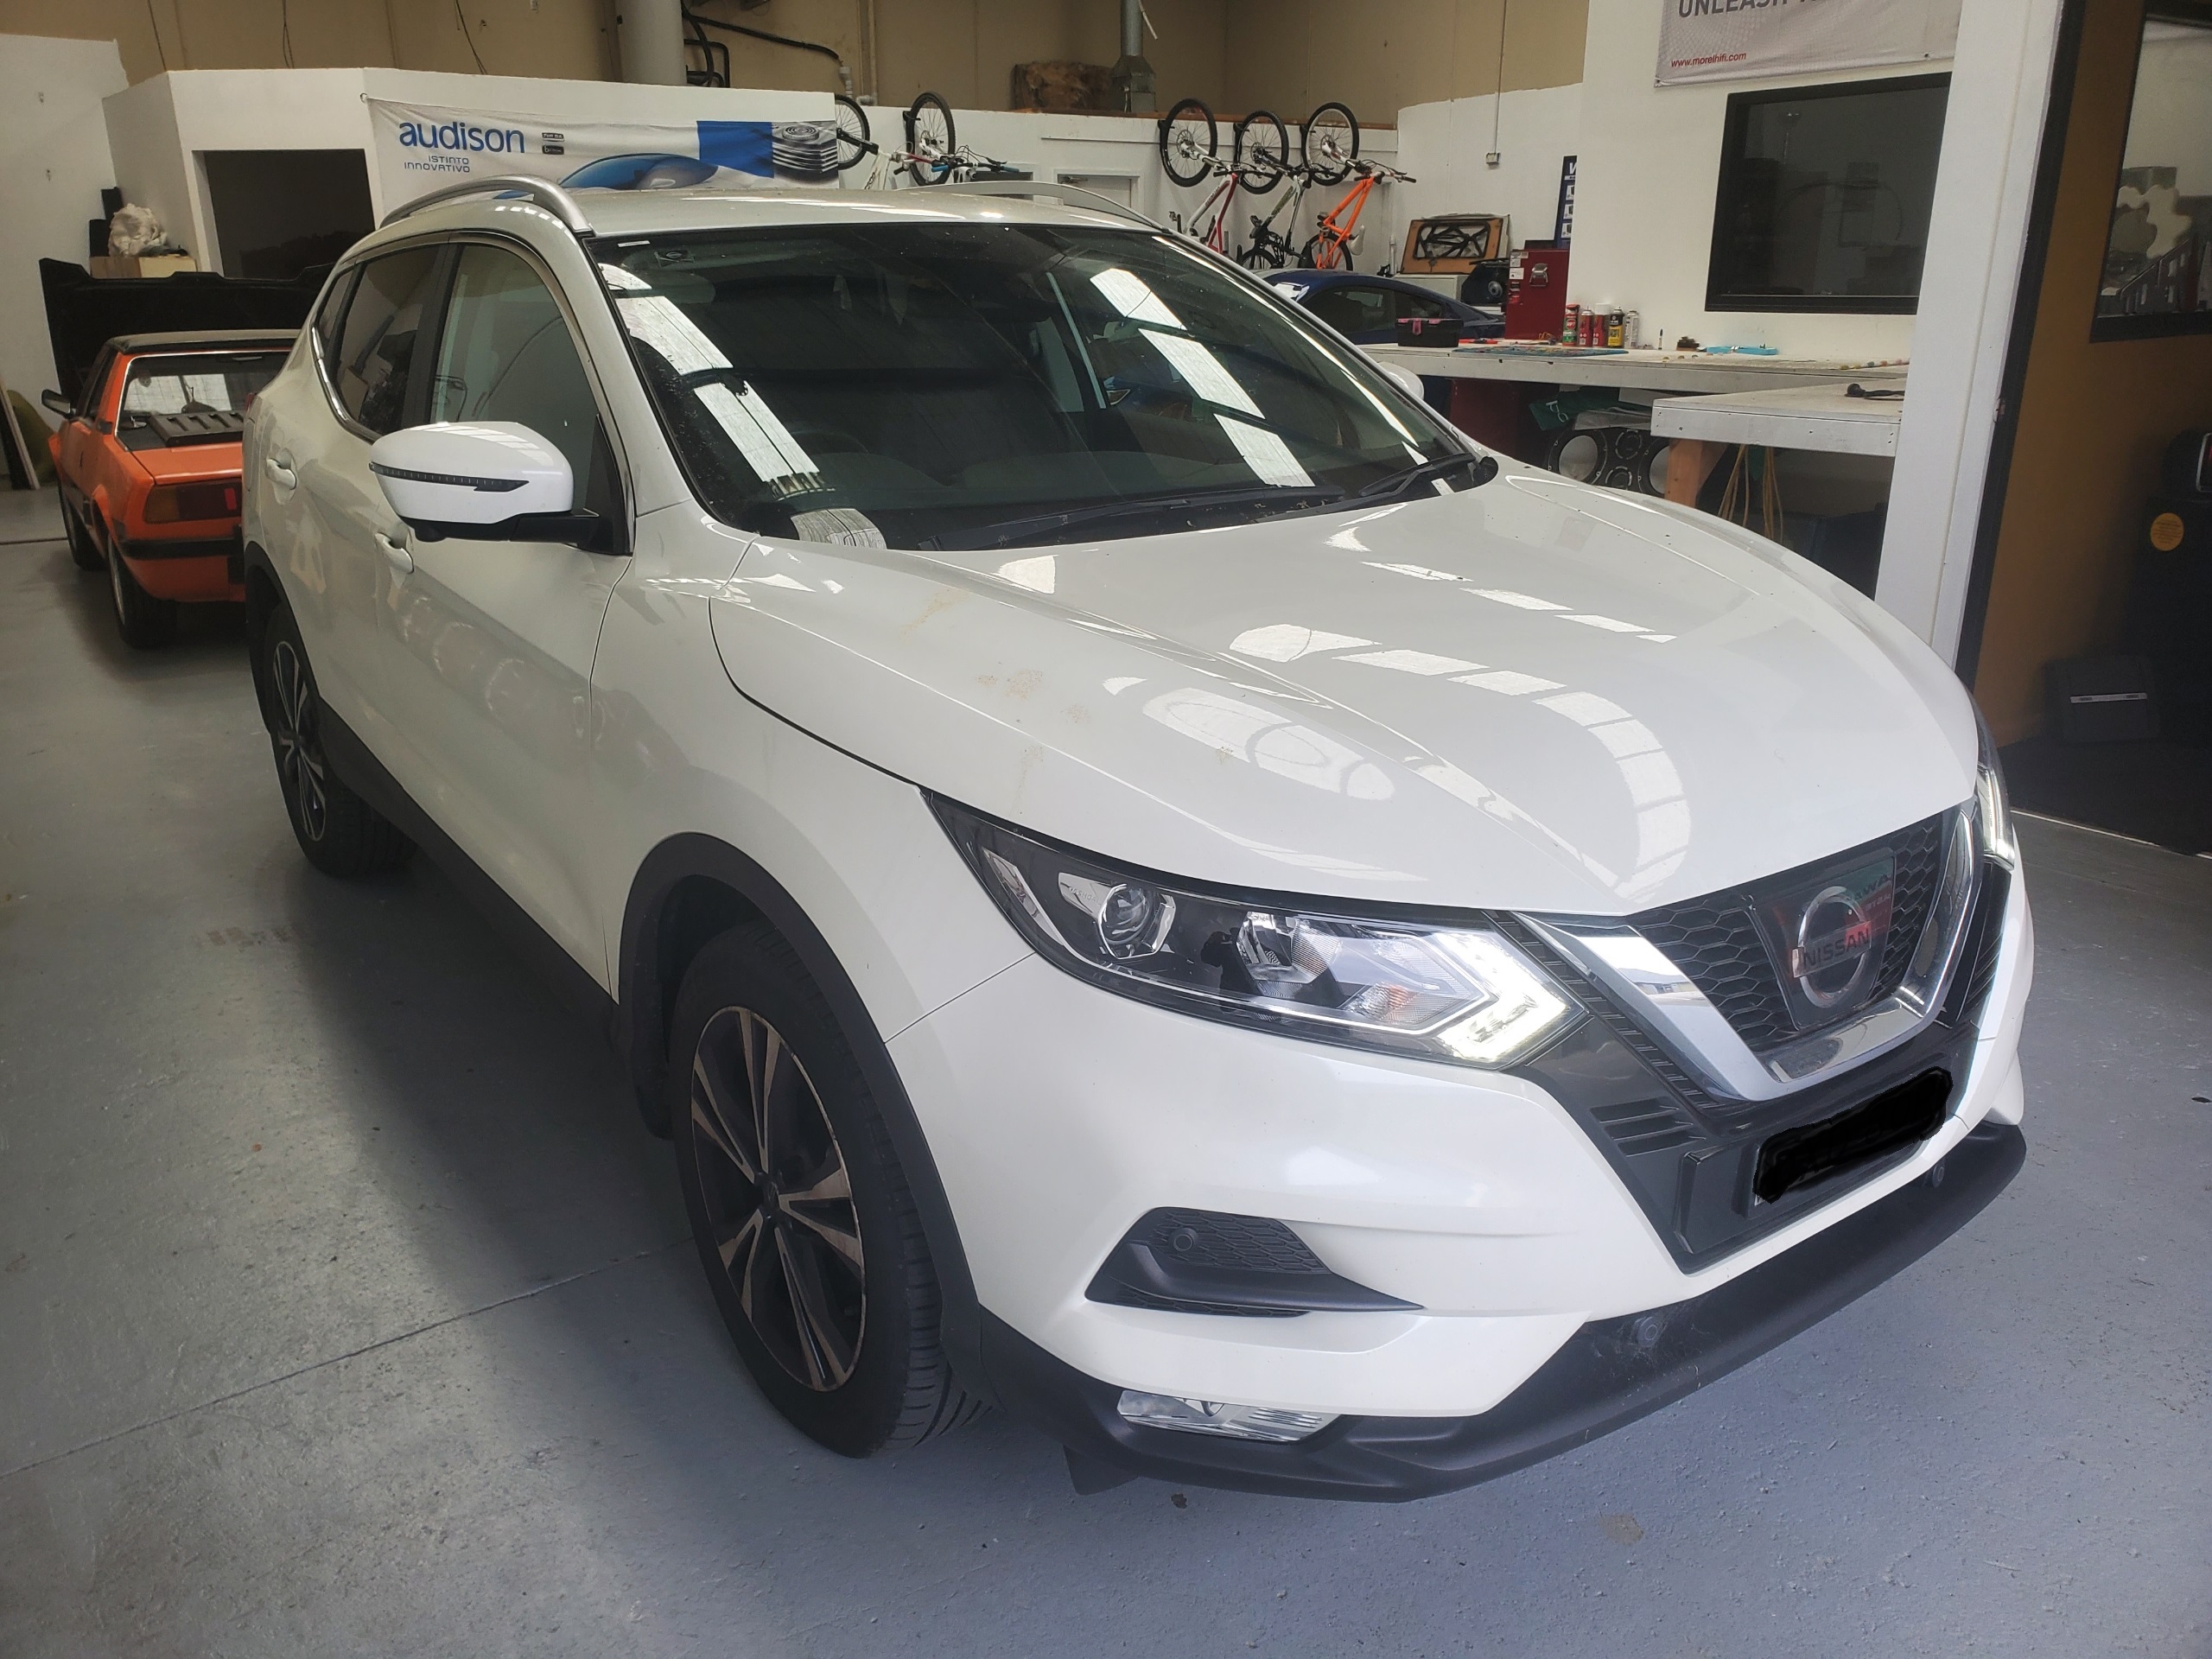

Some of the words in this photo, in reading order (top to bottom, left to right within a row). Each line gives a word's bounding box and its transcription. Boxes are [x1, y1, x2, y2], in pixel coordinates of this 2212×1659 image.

[1679, 0, 1788, 17] UNLEA
[1671, 53, 1746, 67] www.morelhifi.com
[399, 122, 524, 153] audison
[404, 162, 470, 173] INNOVATIVO
[429, 156, 468, 165] ISTINTO
[1803, 928, 1869, 966] NISSAN
